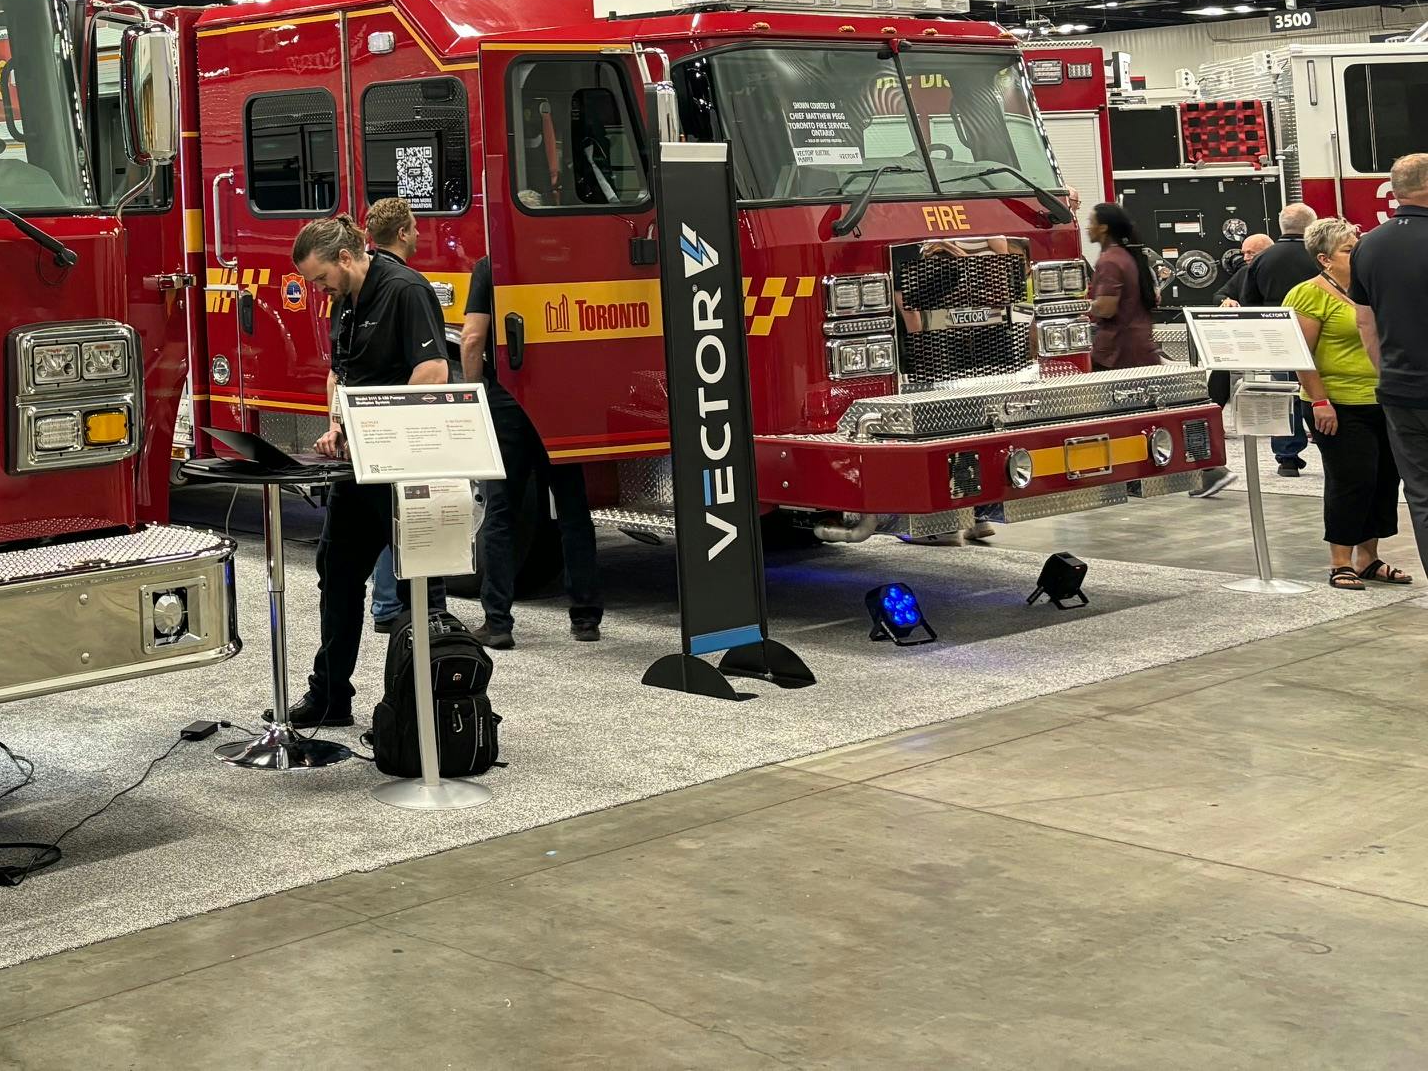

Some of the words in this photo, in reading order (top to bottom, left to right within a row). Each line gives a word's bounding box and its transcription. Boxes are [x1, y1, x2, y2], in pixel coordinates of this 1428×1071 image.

[1274, 12, 1312, 29] 3500
[789, 112, 805, 120] CHIEF
[805, 112, 831, 120] MATTHEW
[811, 129, 835, 137] ONTARIO
[922, 205, 971, 231] FIRE
[575, 298, 651, 332] TORONTO
[952, 311, 984, 324] VECTOR
[692, 284, 739, 562] VECTOR
